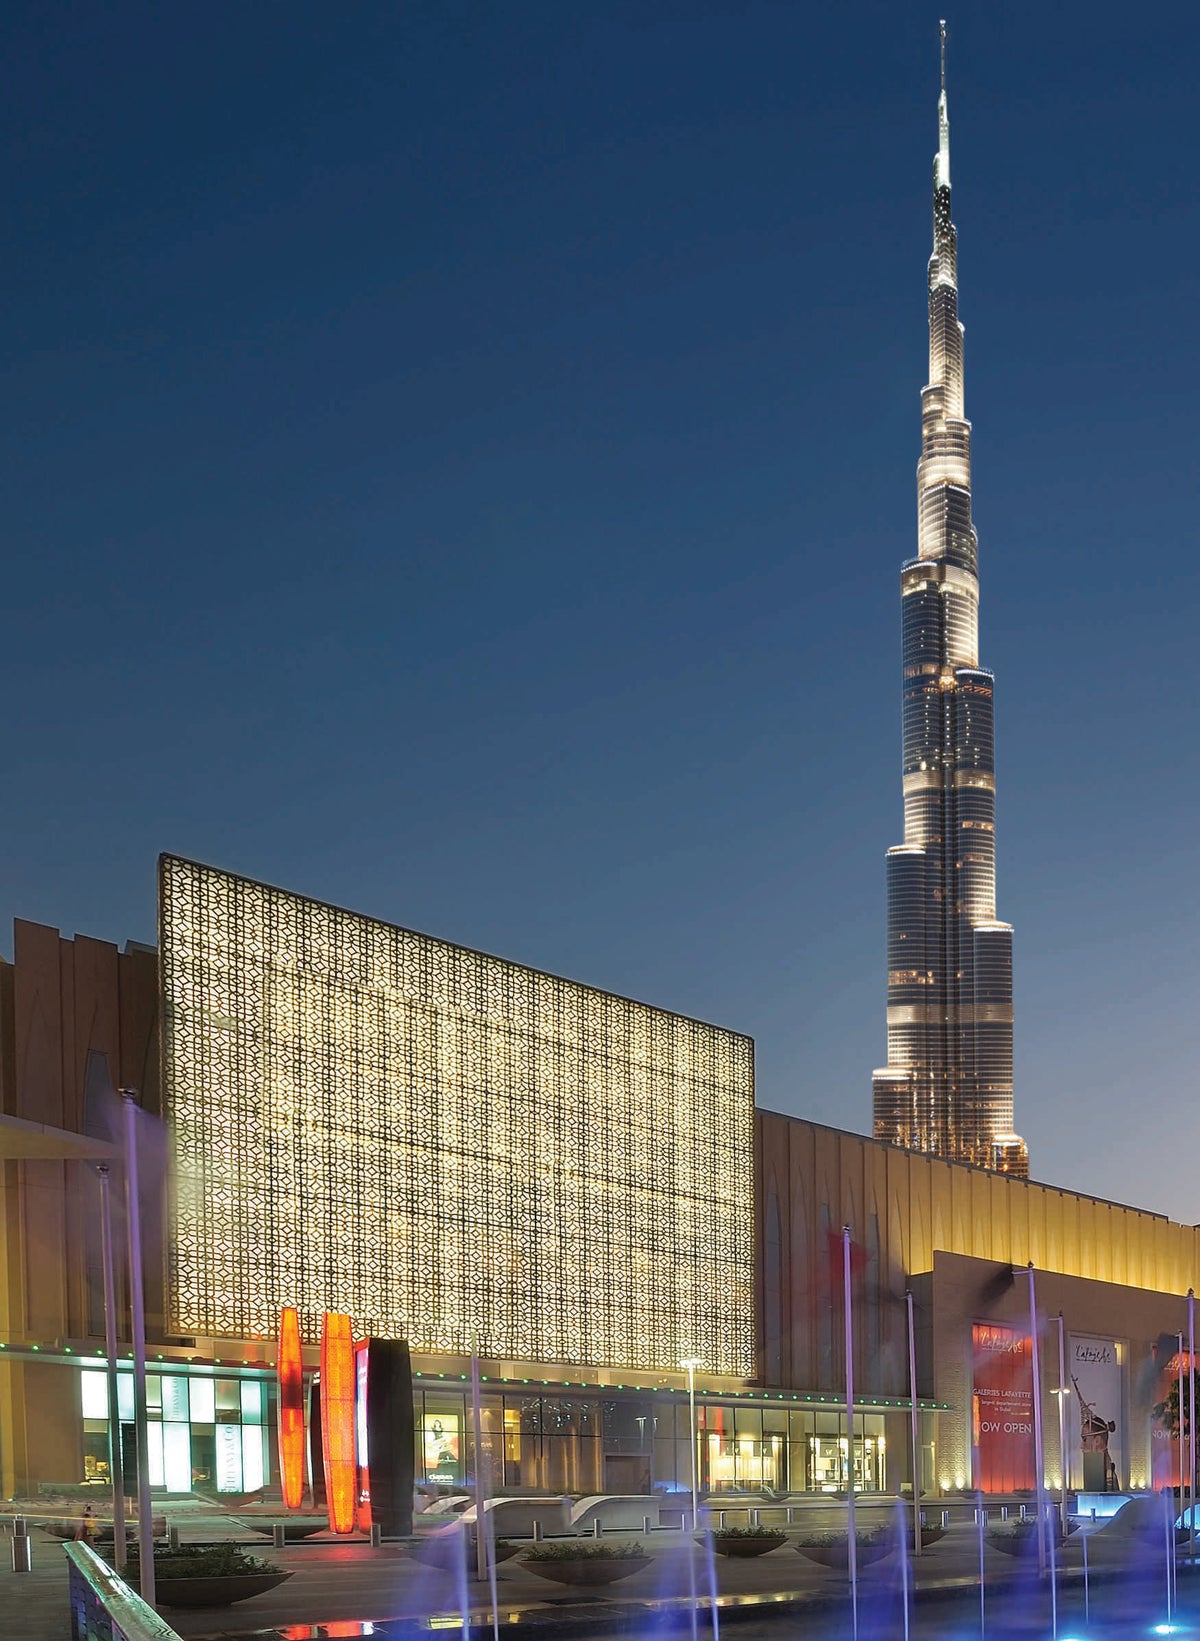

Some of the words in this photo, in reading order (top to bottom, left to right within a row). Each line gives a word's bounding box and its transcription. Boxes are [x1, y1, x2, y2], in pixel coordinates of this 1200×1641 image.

[973, 1388, 1000, 1397] GALERIES
[1001, 1390, 1031, 1399] LAFAYETTE
[977, 1421, 1000, 1433] OW
[1003, 1422, 1032, 1433] OPEN
